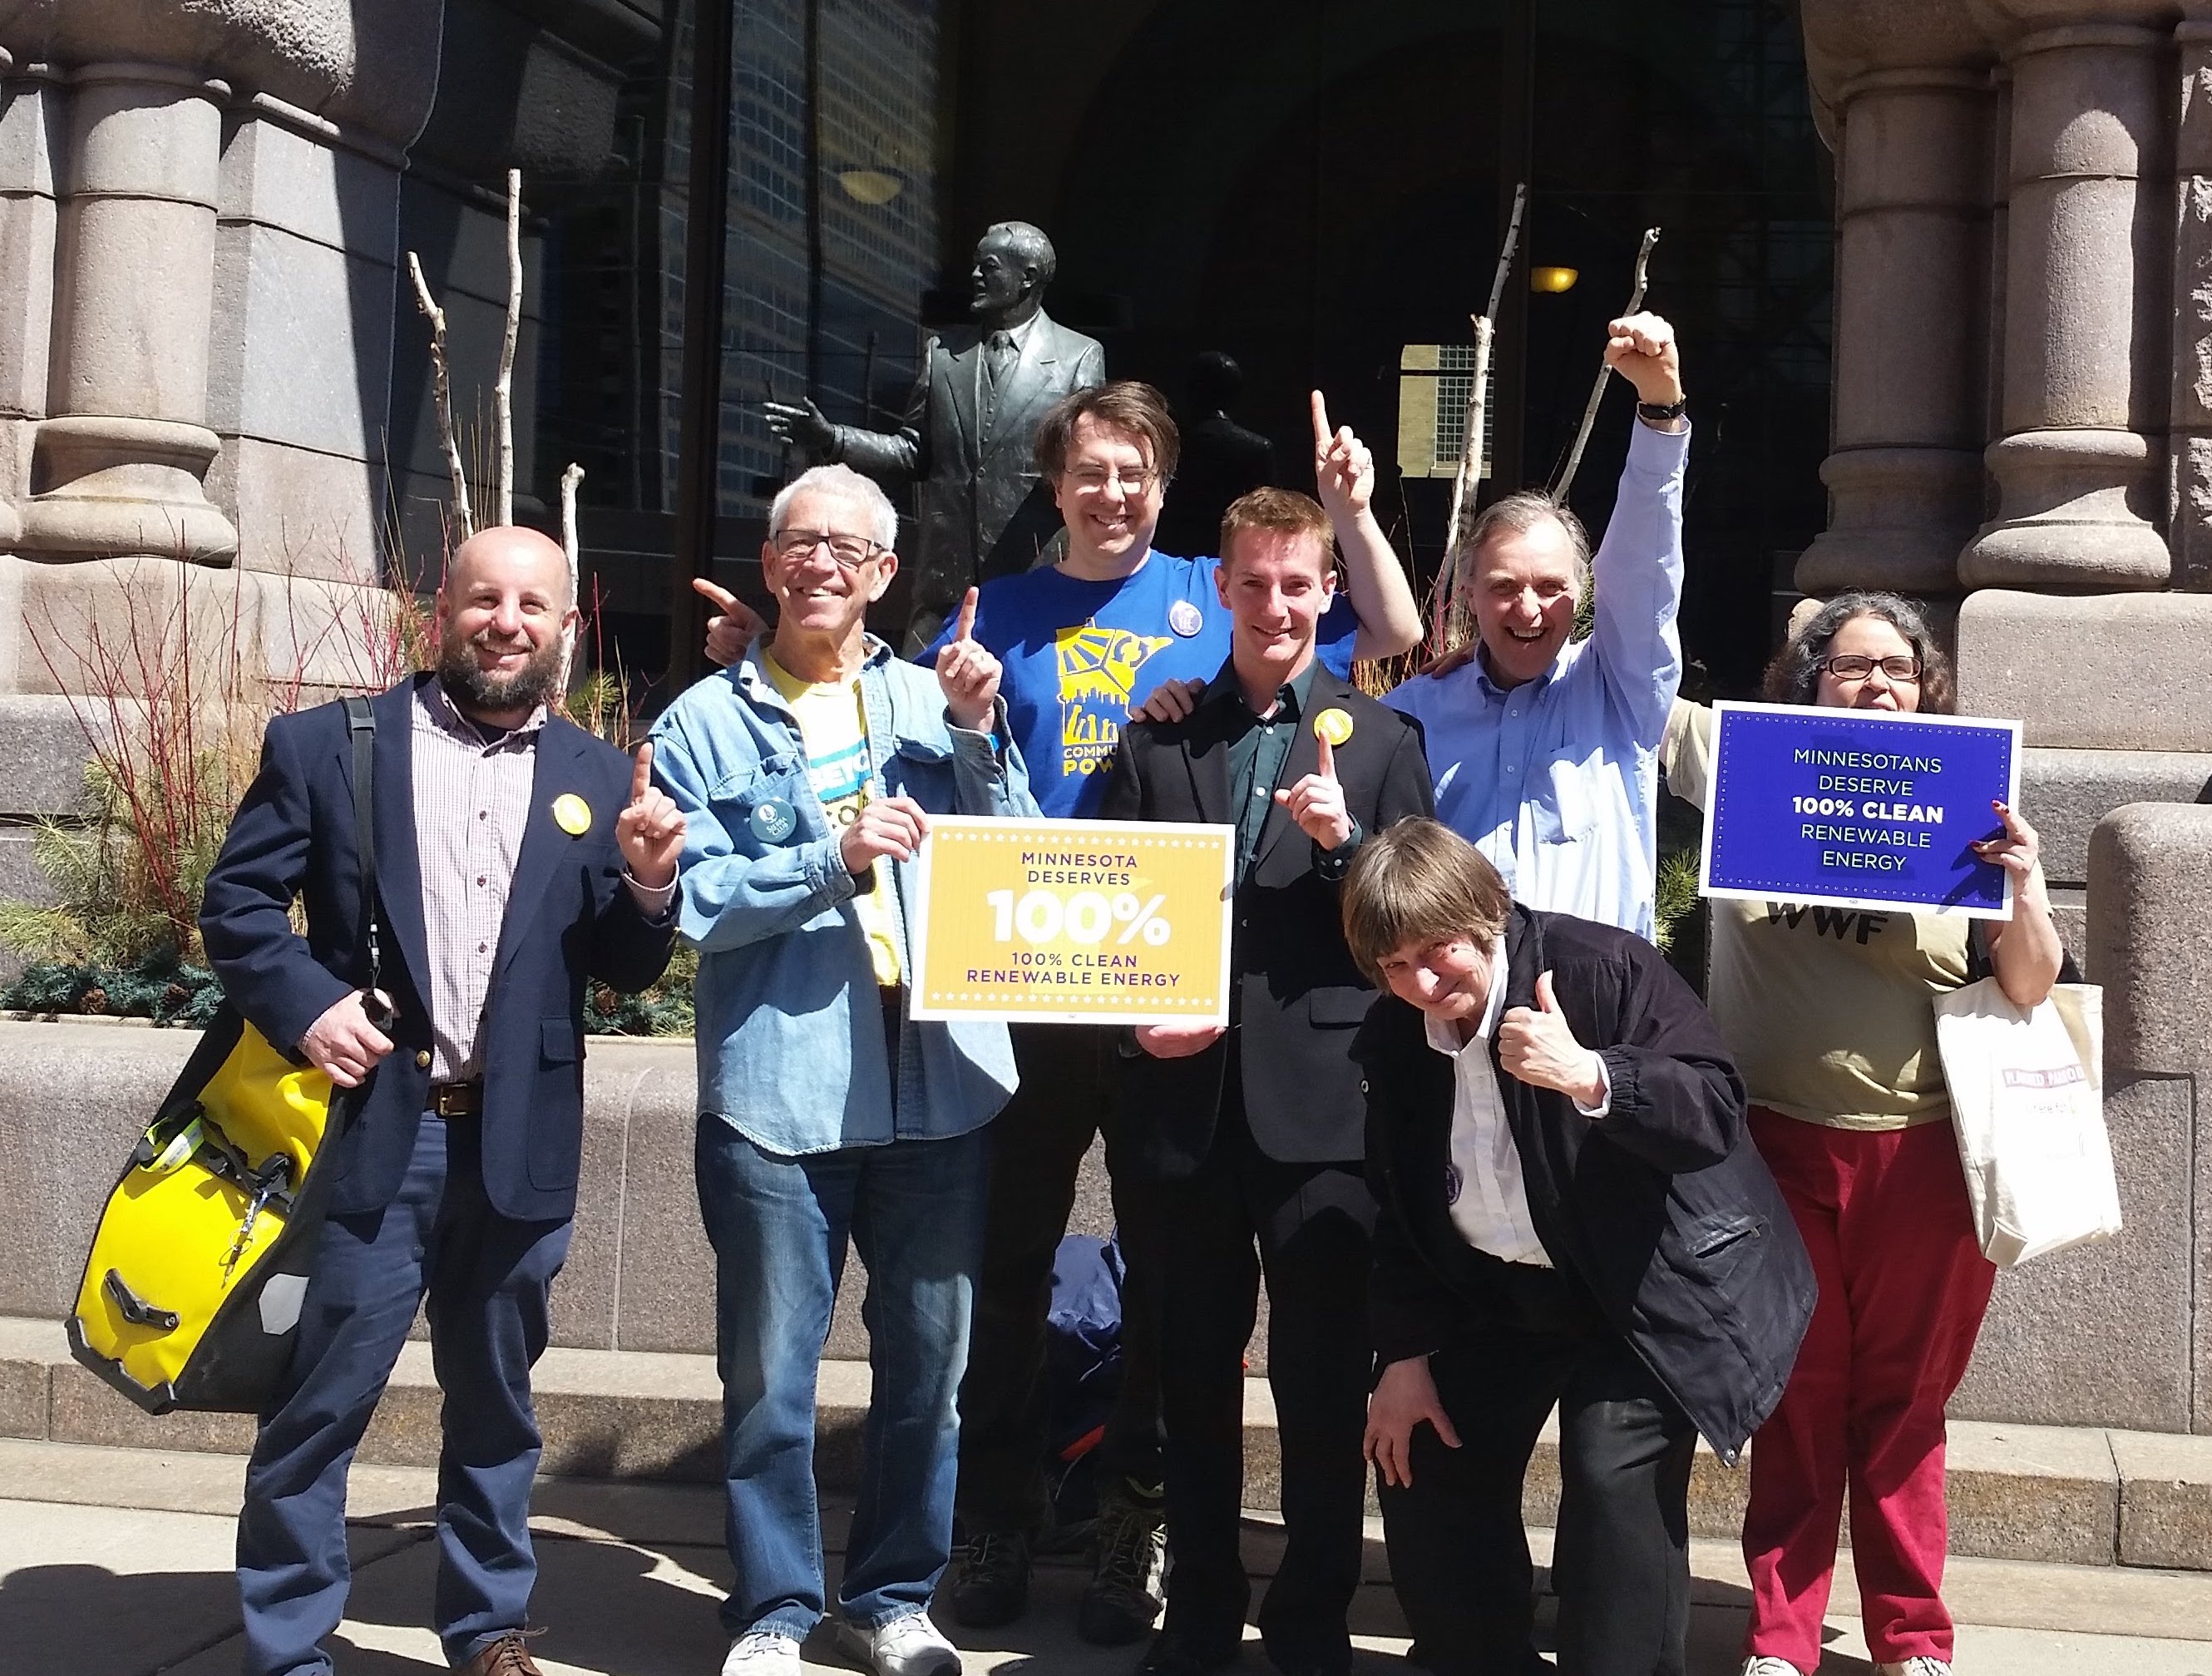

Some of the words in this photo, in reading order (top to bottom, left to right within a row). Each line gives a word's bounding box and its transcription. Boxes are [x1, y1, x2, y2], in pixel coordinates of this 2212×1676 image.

[1794, 749, 1942, 774] MINNESOTANS
[1819, 775, 1914, 796] DESERVE
[1792, 796, 1854, 818] 100%
[1861, 801, 1943, 824] CLEAN
[1801, 823, 1932, 848] RENEWABLE
[1021, 852, 1138, 868] MINNESOTA
[1823, 850, 1907, 871] ENERGY
[1028, 870, 1130, 886] DESERVES
[986, 888, 1171, 946] 100%
[1765, 901, 1889, 945] WWF
[1011, 952, 1062, 966] 100%
[1071, 953, 1137, 967] CLEAN
[966, 969, 1092, 985] RENEWABLE
[1101, 972, 1180, 987] ENERGY
